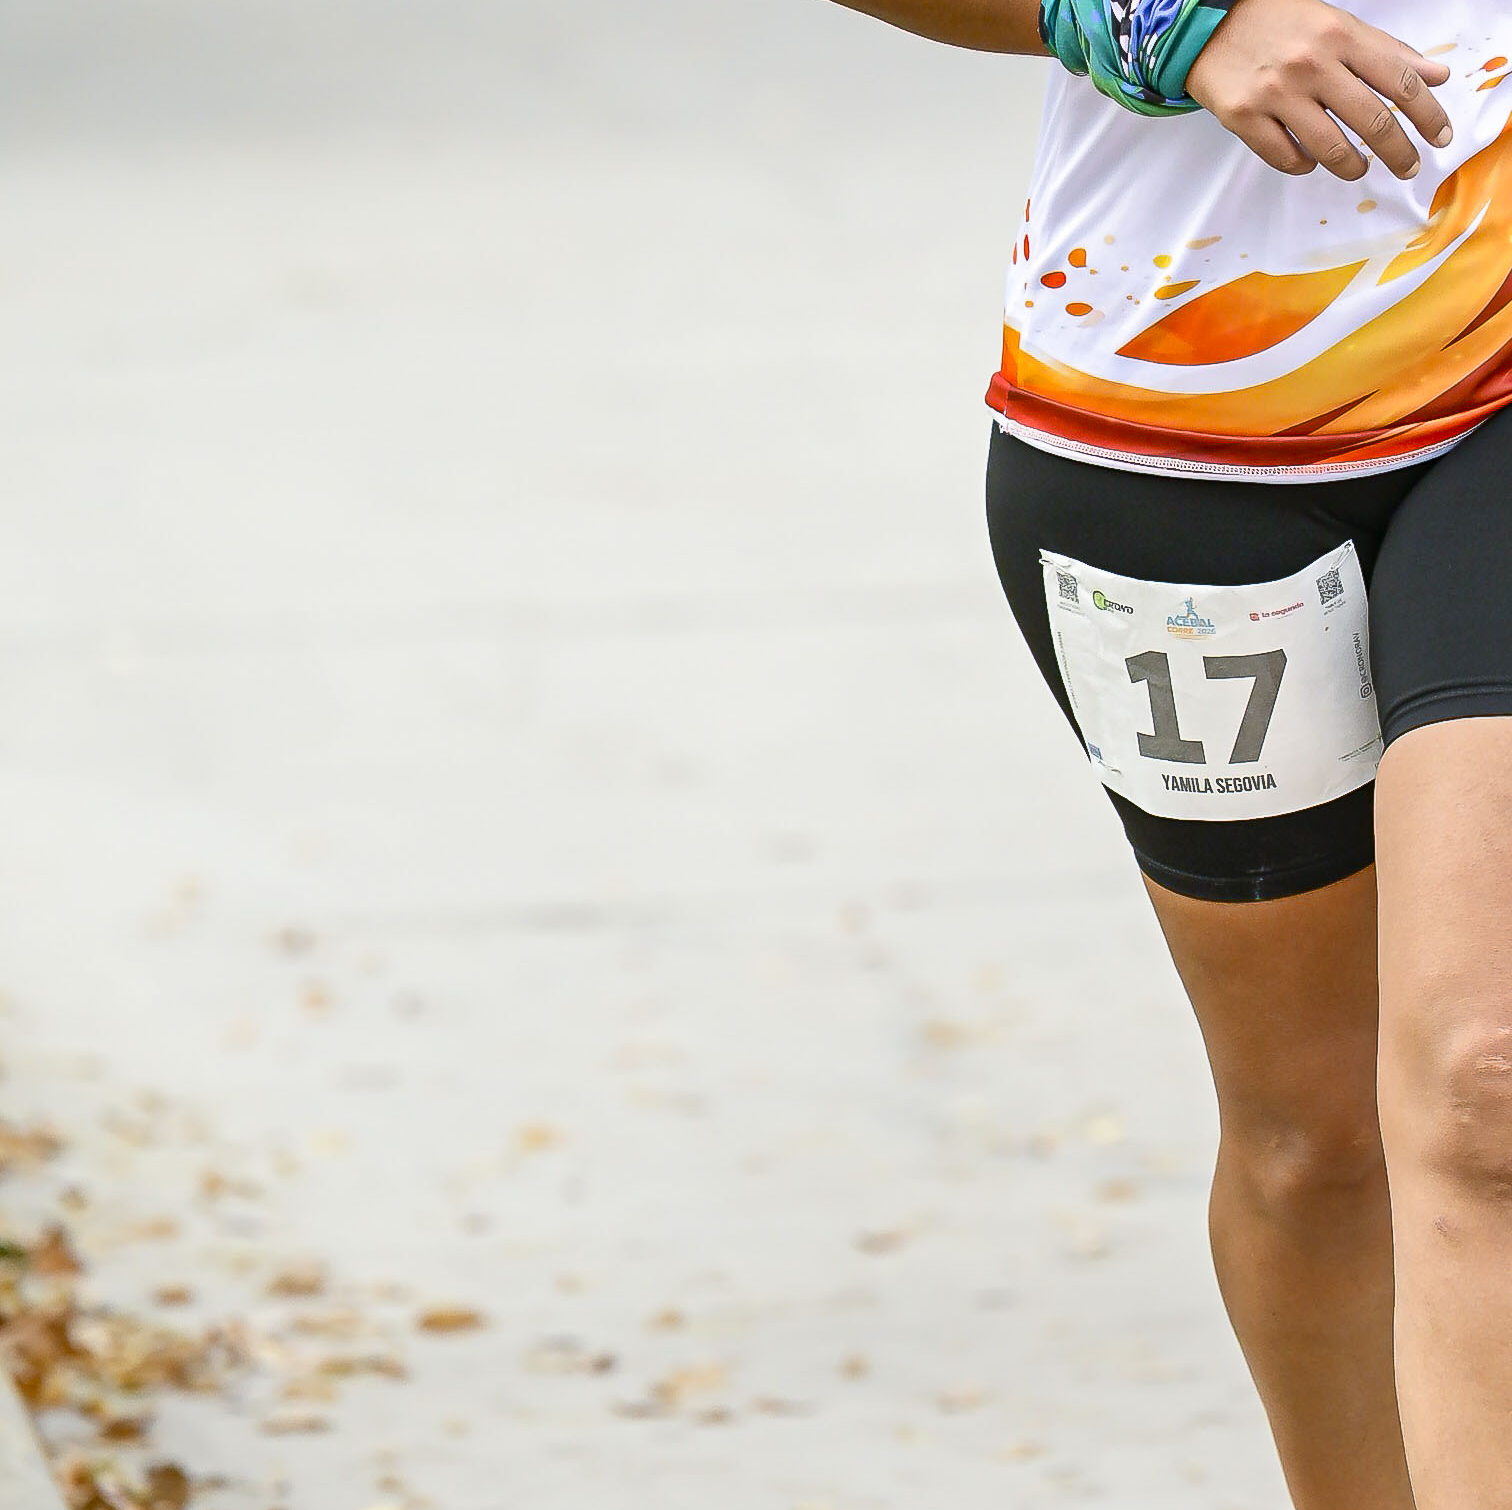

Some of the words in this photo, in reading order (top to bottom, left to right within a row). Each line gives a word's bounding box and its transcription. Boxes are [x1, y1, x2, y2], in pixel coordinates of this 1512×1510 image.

[1166, 615, 1215, 627] ACEBAL
[1124, 648, 1288, 765] 17
[1161, 773, 1214, 794] YAMILA
[1215, 773, 1278, 794] SEGOVIA
